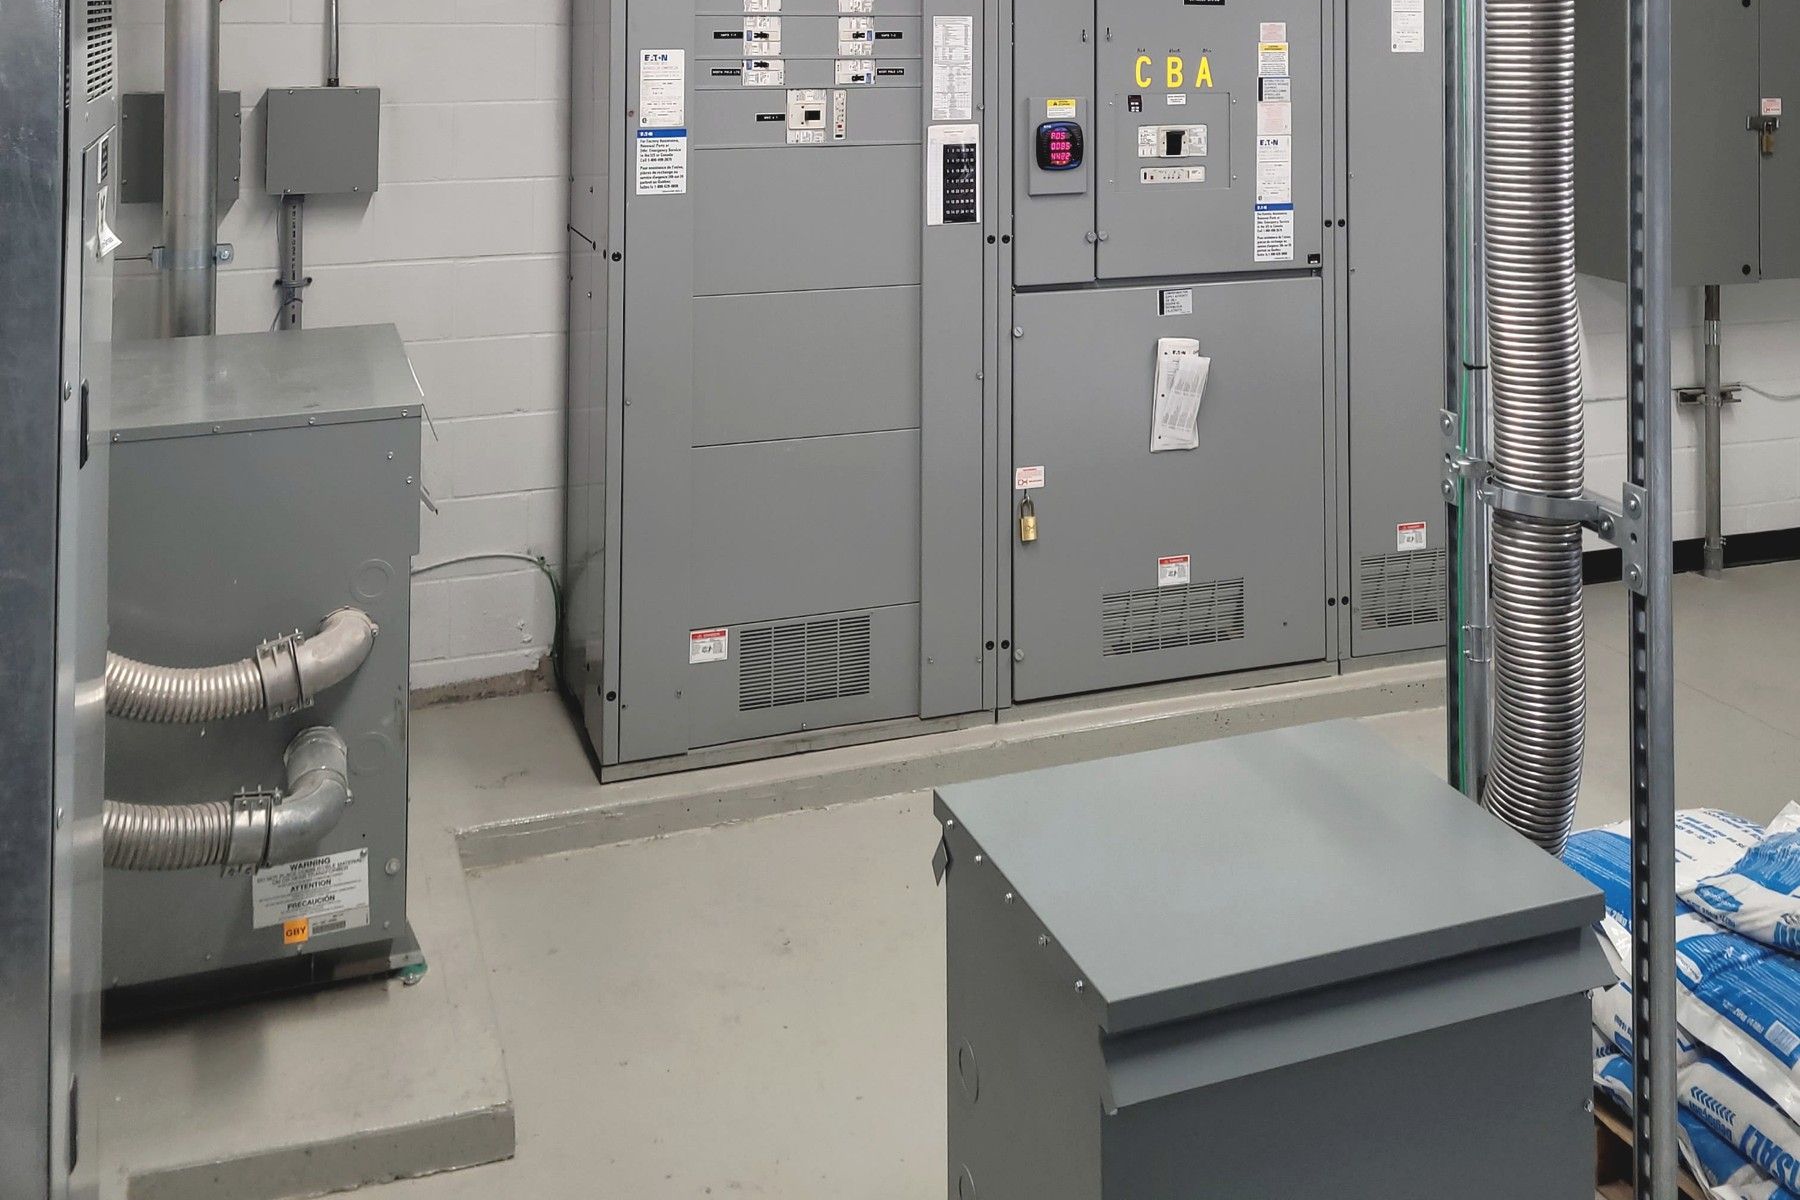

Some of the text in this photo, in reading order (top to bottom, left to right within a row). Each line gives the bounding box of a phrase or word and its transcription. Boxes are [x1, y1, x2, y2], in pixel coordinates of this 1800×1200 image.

[1135, 54, 1214, 88] C B A
[290, 857, 330, 871] WARNING
[290, 879, 332, 892] ATTENTION
[287, 895, 336, 910] PRECAUCIÓN
[286, 926, 306, 937] GBY
